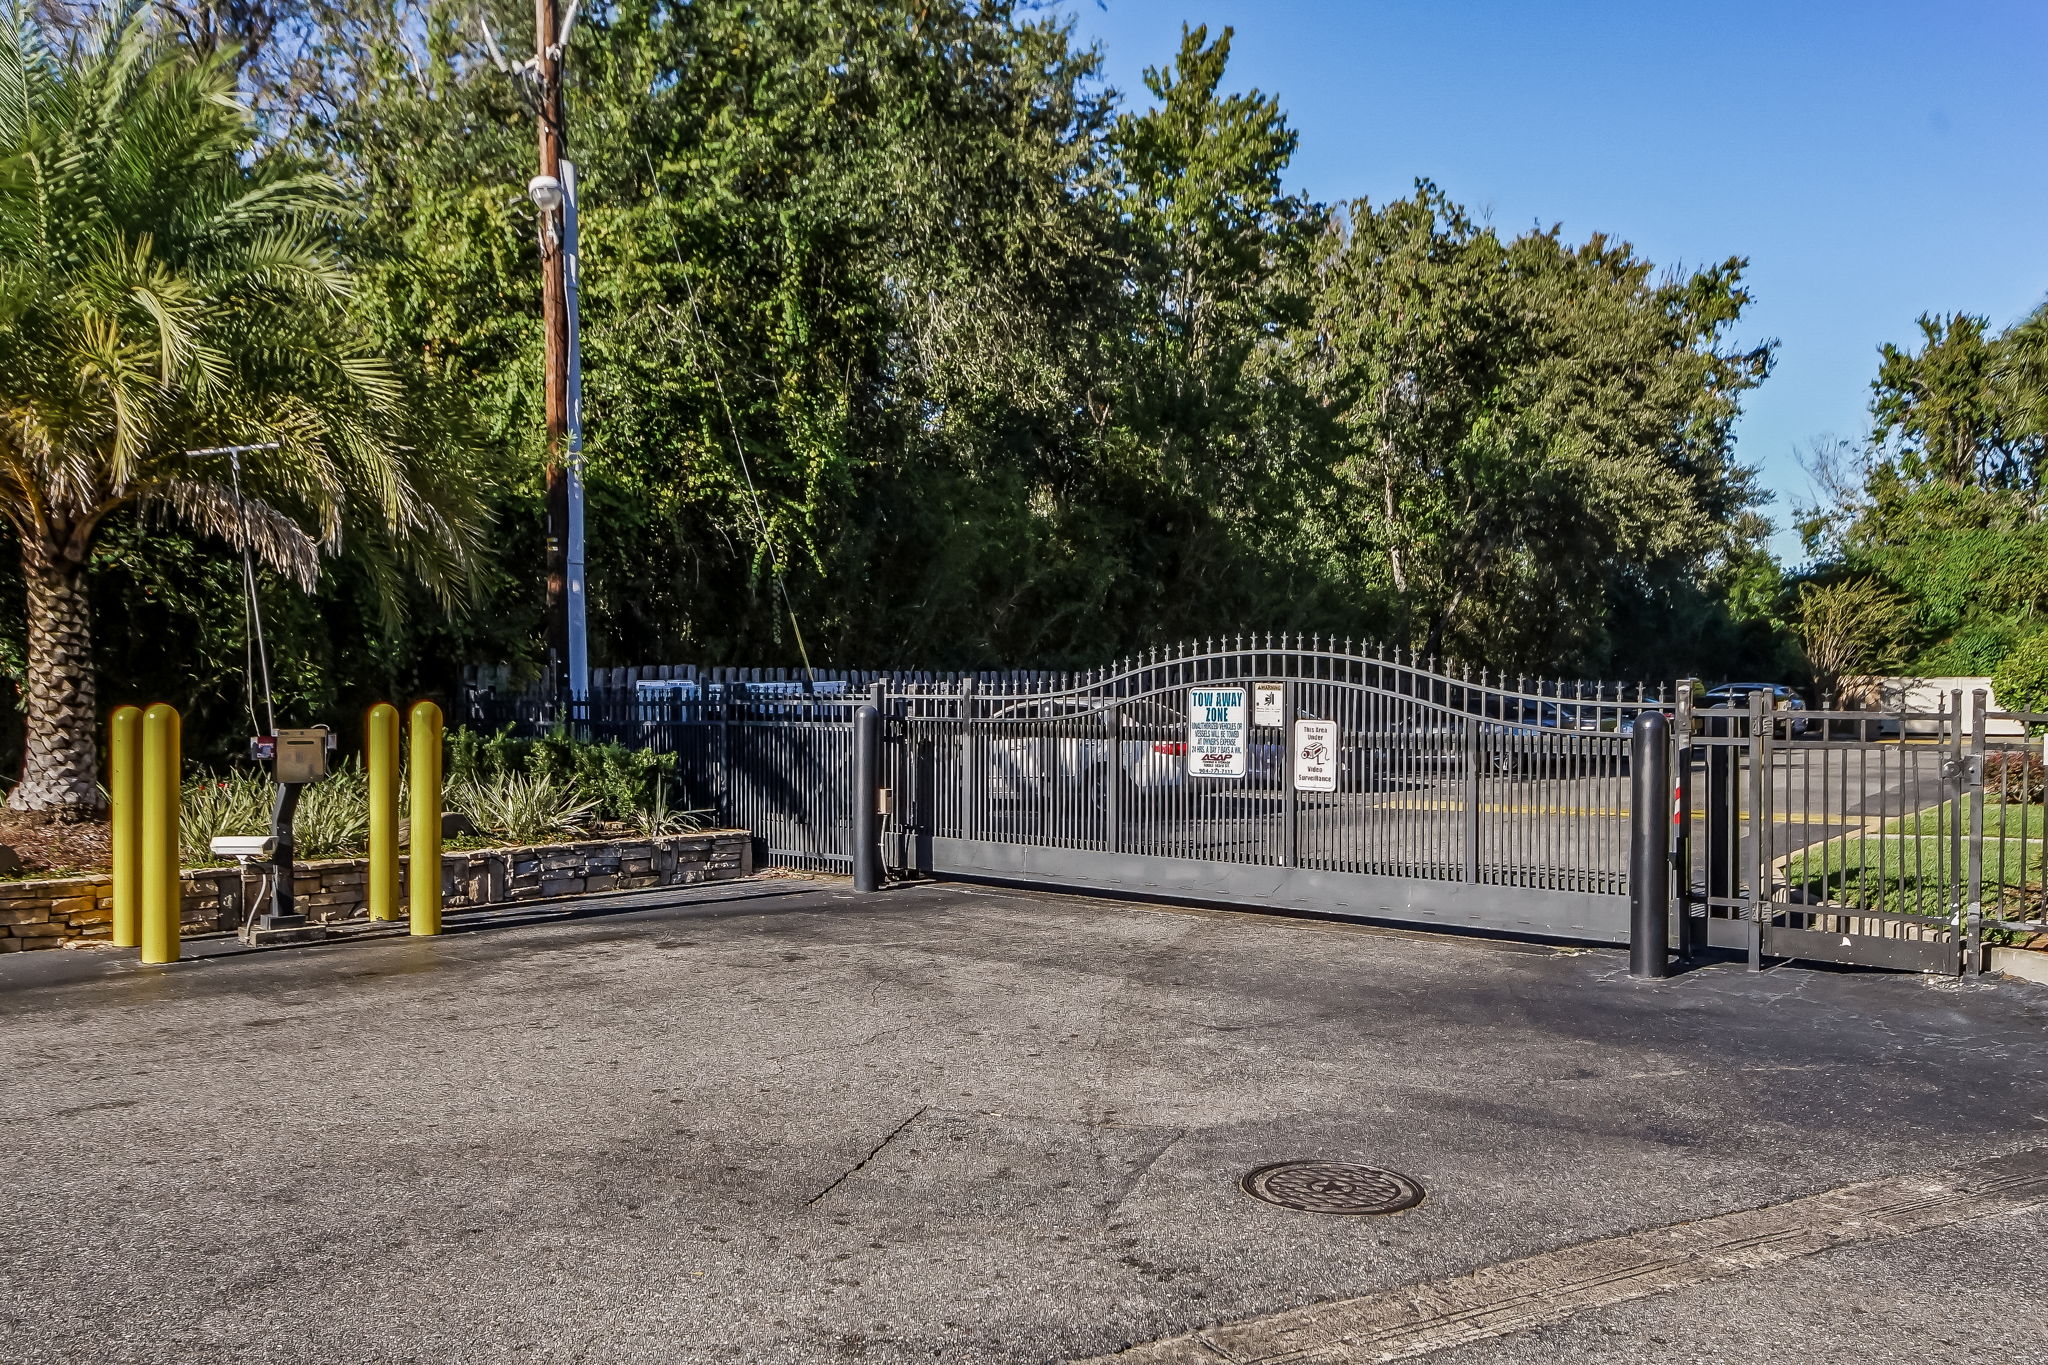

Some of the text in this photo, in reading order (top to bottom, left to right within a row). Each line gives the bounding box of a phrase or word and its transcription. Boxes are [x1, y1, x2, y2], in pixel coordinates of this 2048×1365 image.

[1192, 692, 1242, 707] TOW AWAY
[1206, 708, 1228, 722] ZONE
